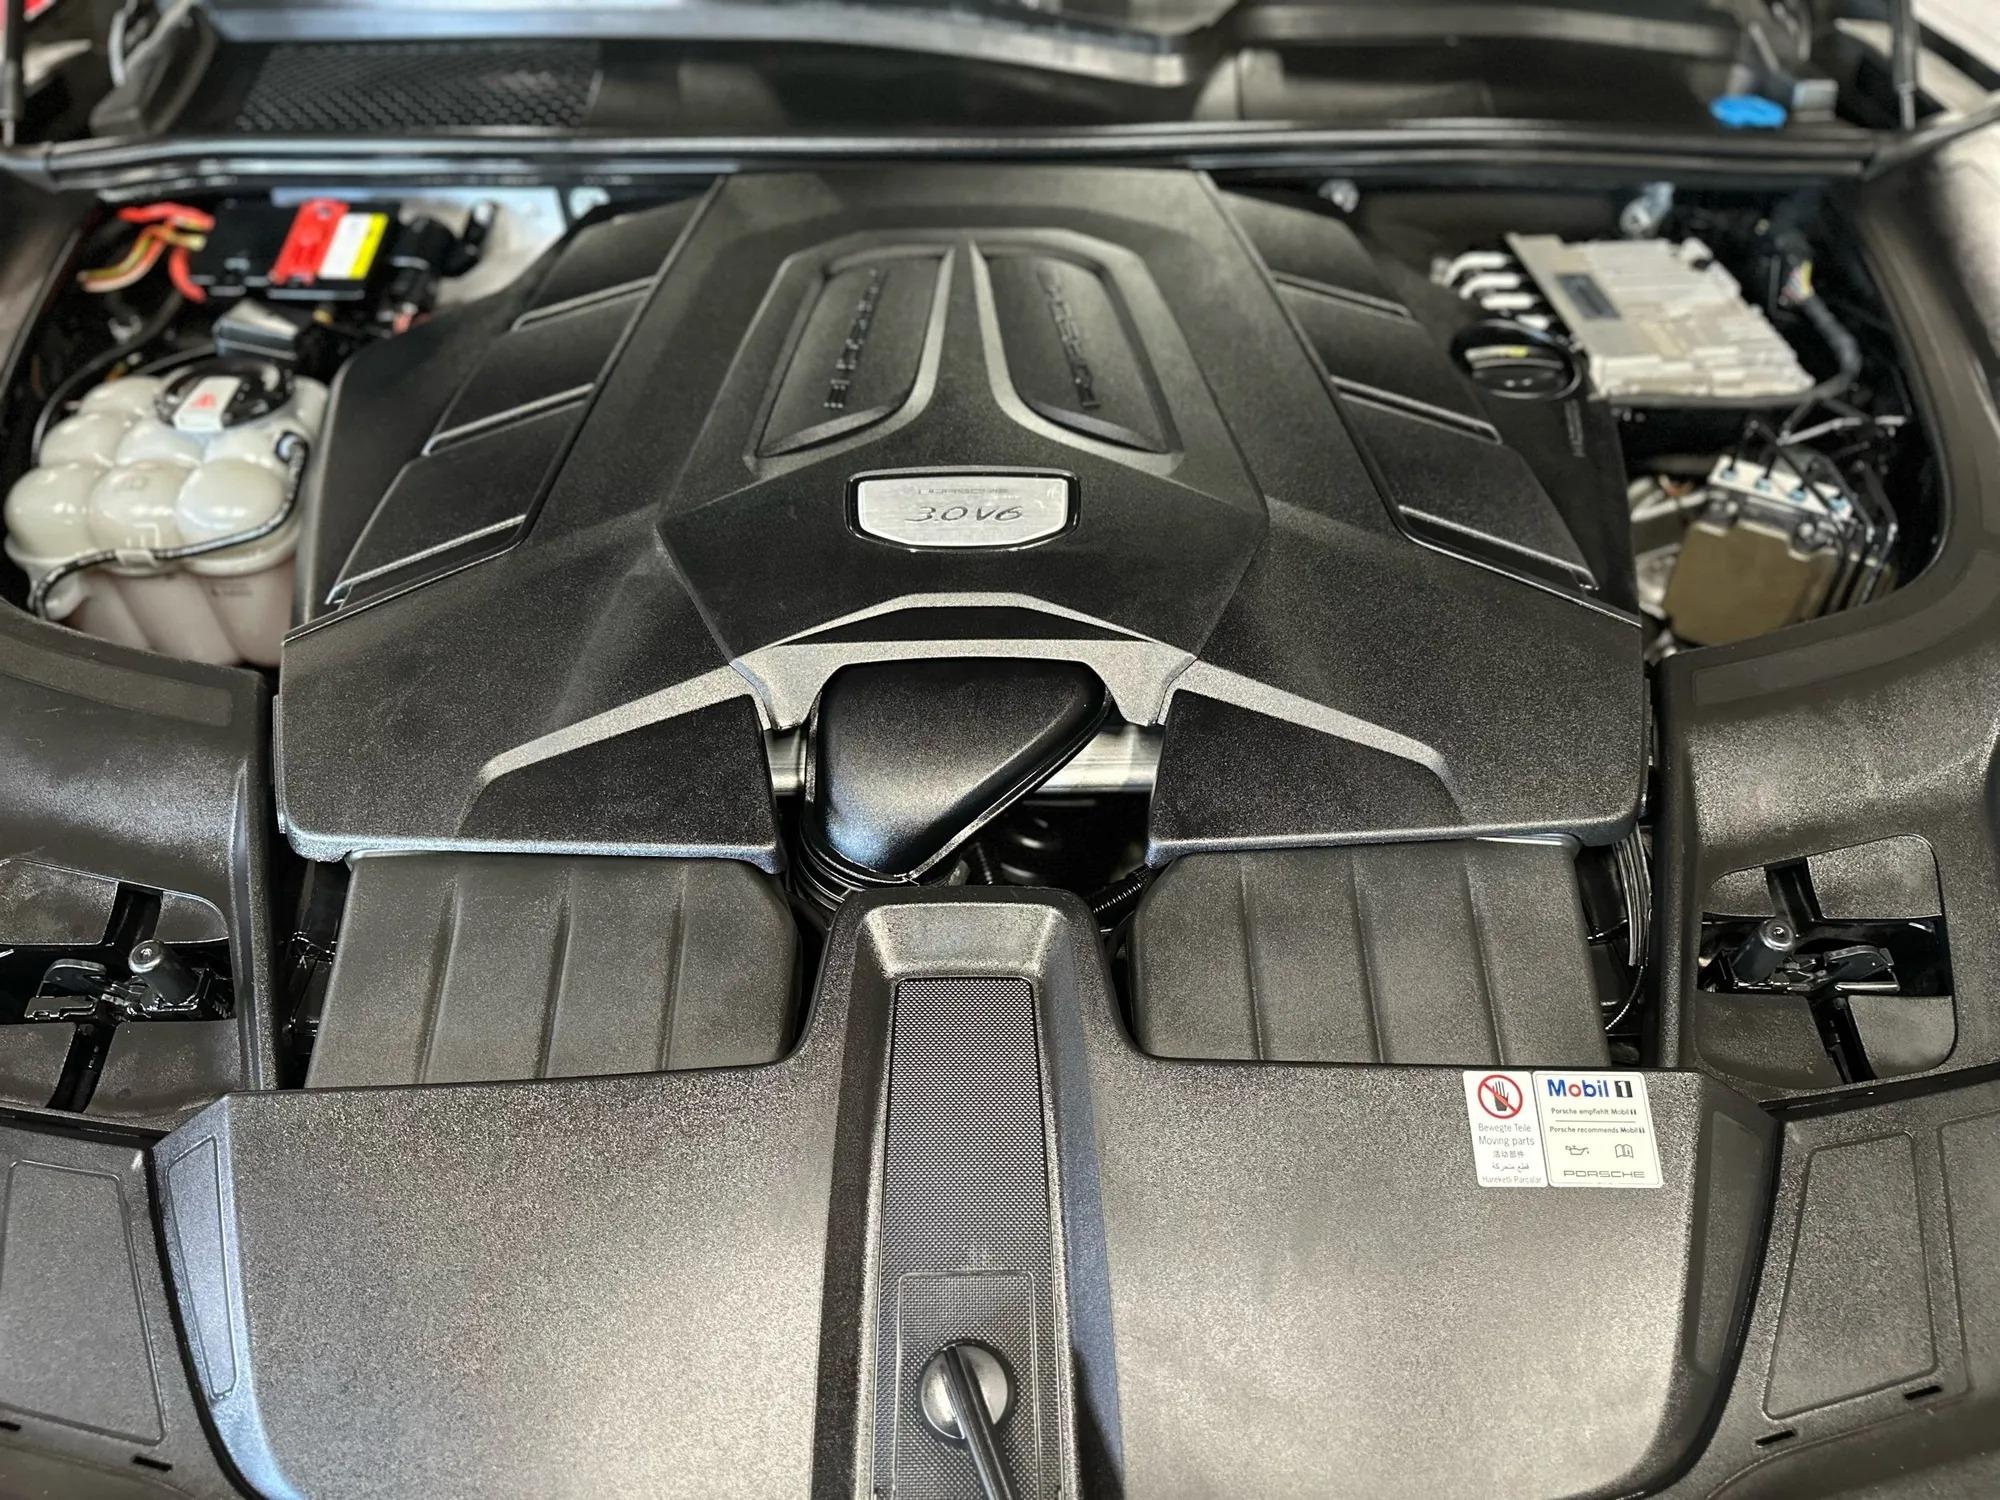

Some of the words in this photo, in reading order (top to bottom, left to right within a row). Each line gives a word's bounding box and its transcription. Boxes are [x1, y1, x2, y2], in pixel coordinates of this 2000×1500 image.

[976, 506, 1024, 522] V6
[1546, 1079, 1610, 1098] Mobil
[1615, 1081, 1632, 1098] 1
[1551, 1107, 1577, 1115] Porsche
[1478, 1123, 1512, 1133] Bewegte
[1514, 1123, 1532, 1132] Teile
[1549, 1126, 1576, 1134] Porsche
[1478, 1136, 1509, 1146] Moving
[1512, 1136, 1535, 1146] parts
[1563, 1169, 1646, 1179] PORSCHE
